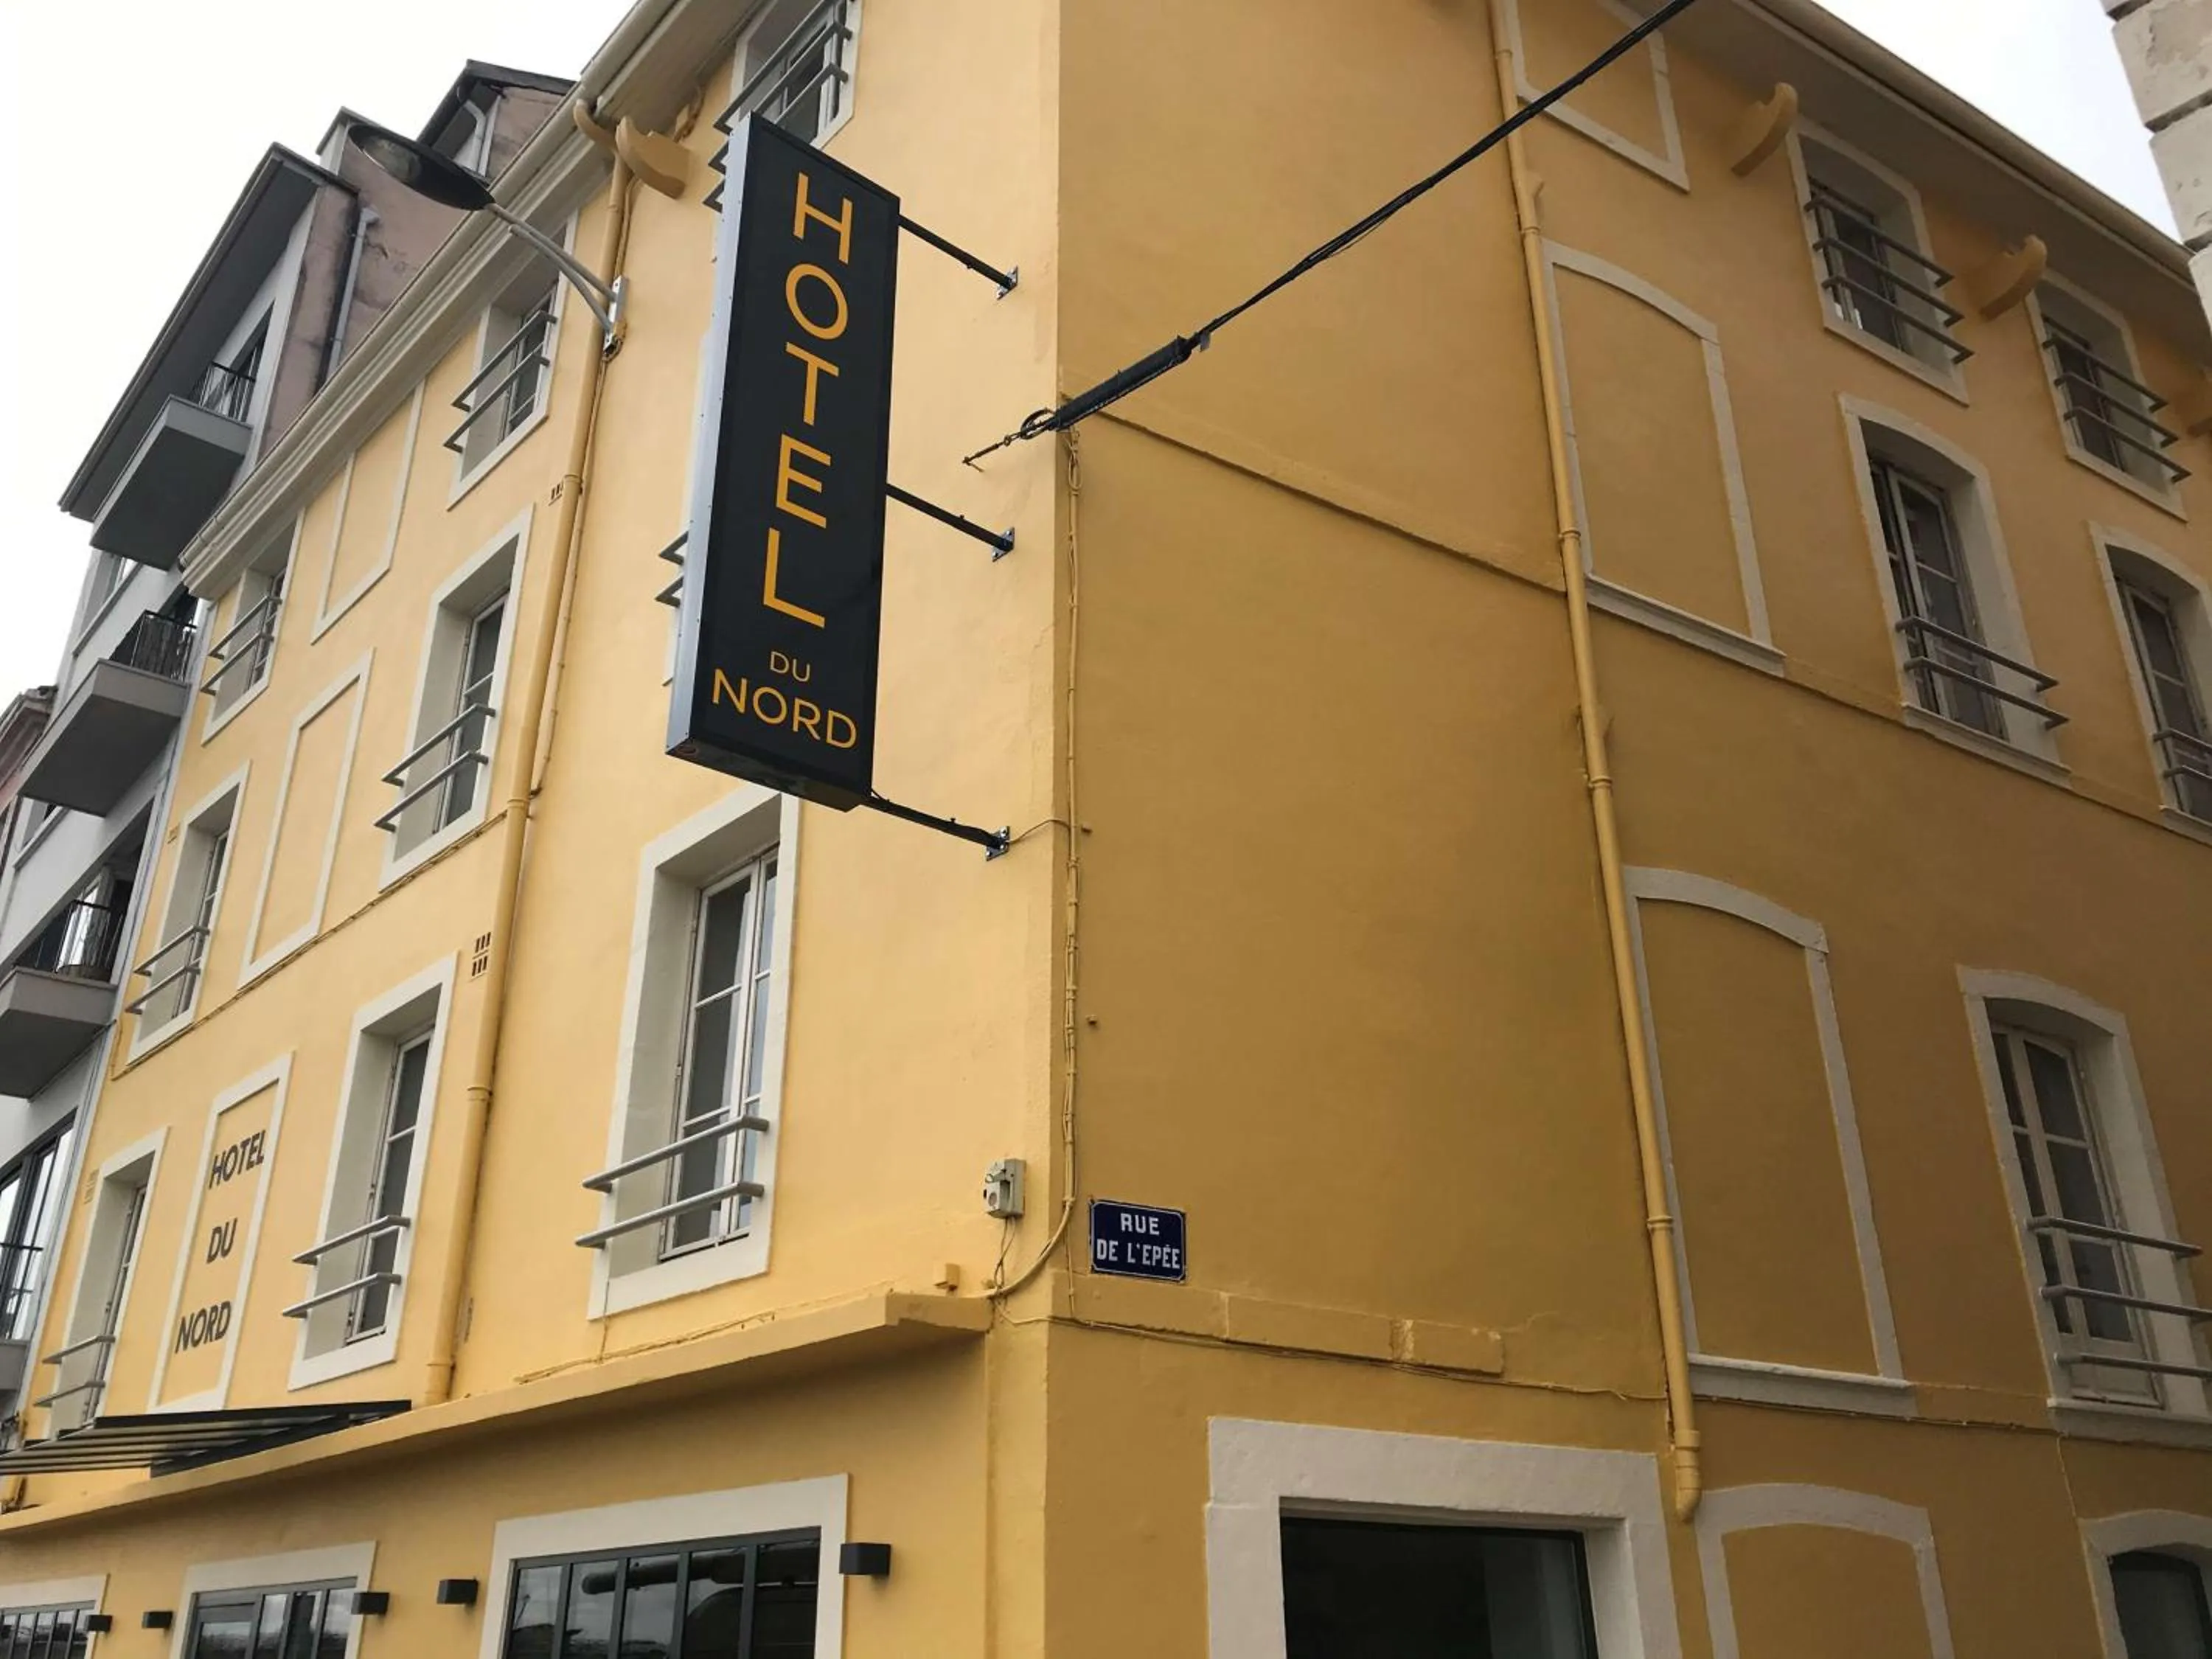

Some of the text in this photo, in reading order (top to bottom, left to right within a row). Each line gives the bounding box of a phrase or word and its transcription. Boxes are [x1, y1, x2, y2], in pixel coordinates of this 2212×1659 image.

[763, 172, 852, 628] HOTEL
[770, 651, 810, 683] DU
[712, 668, 858, 748] NORD
[208, 1130, 266, 1189] HOTEL
[206, 1218, 237, 1264] DU
[1120, 1213, 1160, 1235] RUE
[1096, 1238, 1119, 1262] DE
[175, 1301, 232, 1354] NORD
